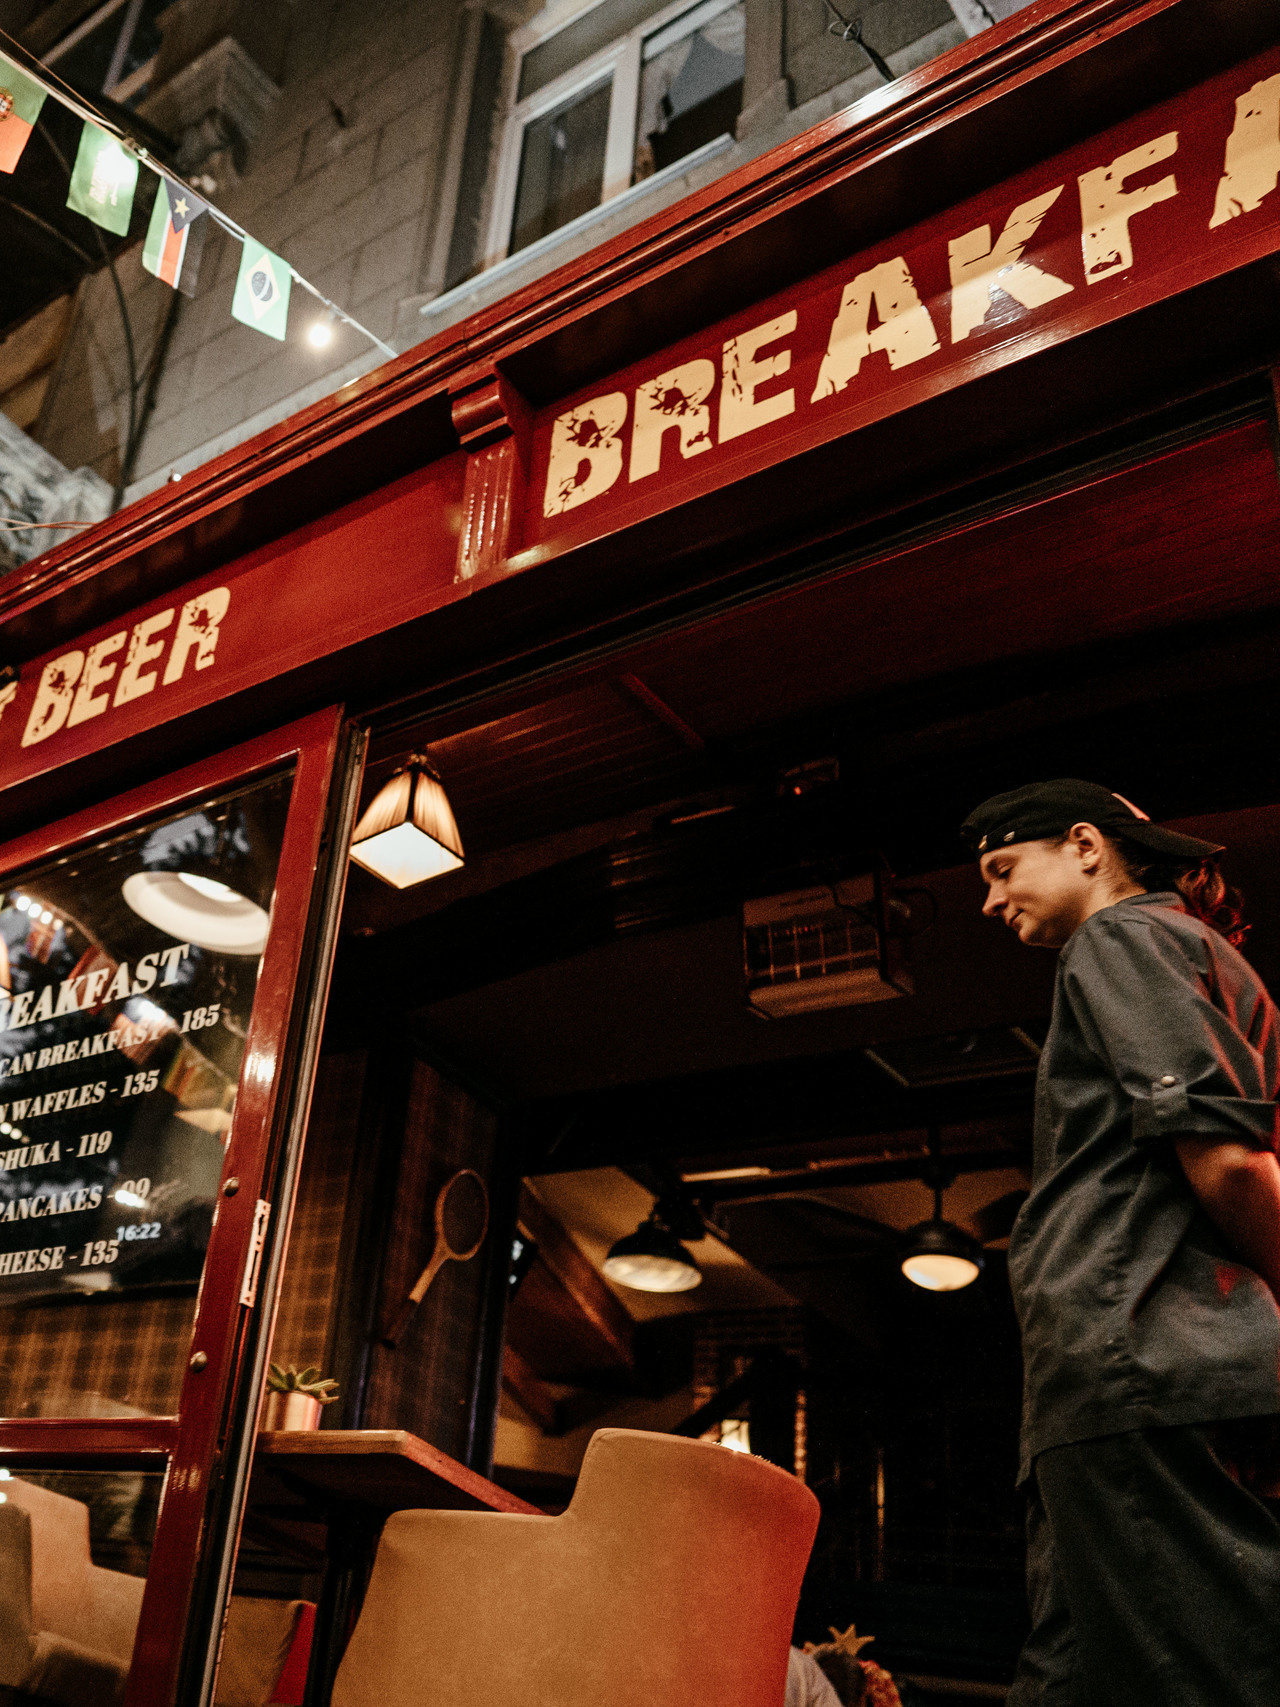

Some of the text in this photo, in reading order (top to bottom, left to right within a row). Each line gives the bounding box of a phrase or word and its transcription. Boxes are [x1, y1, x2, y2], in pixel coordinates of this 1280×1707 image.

[21, 586, 230, 748] BEER
[36, 1020, 163, 1070] BREAKFAST
[180, 1003, 221, 1034] 185
[11, 1081, 107, 1122] WAFFLES
[120, 1069, 161, 1098] 135
[76, 1130, 113, 1158] 119
[116, 1221, 162, 1242] 16:22
[80, 1239, 120, 1267] 135
